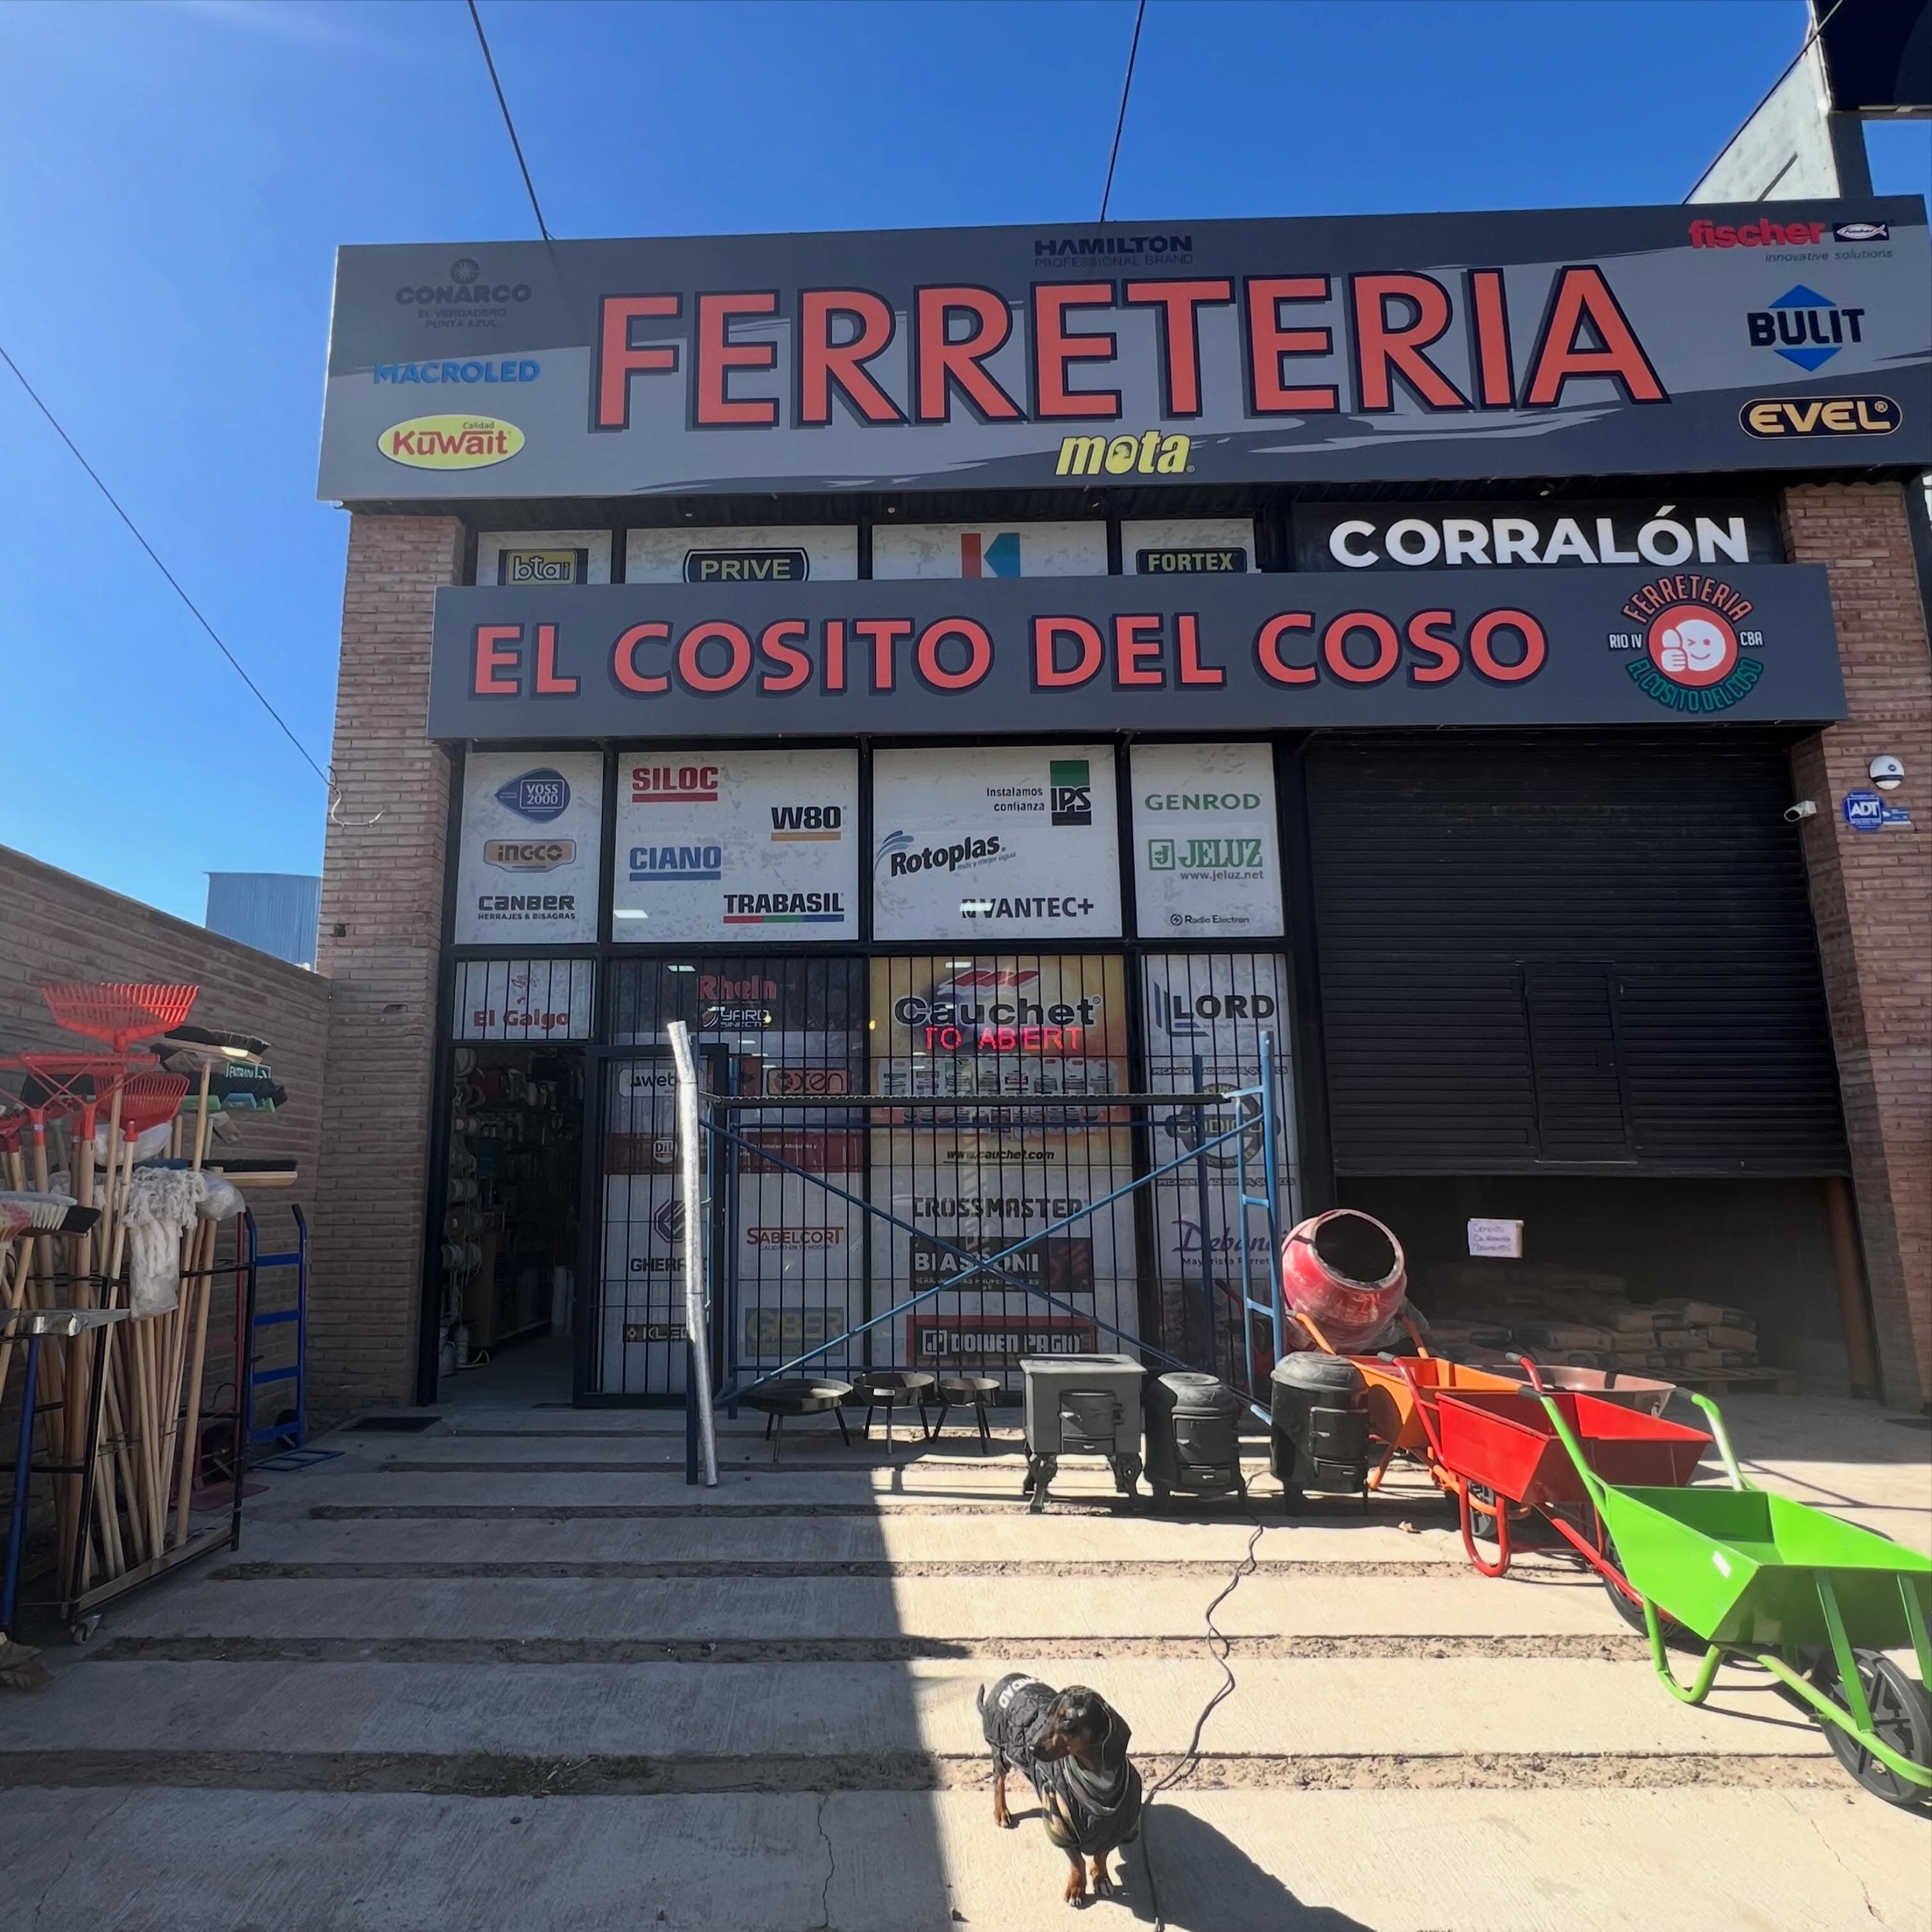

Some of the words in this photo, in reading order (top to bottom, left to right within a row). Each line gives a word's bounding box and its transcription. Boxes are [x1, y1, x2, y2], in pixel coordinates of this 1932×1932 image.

[1688, 218, 1826, 249] fischer
[1034, 235, 1193, 257] HAMILTON
[1765, 252, 1829, 263] innovative
[1834, 249, 1894, 261] solutions
[1034, 256, 1140, 269] PROFESSIONAL
[1145, 254, 1193, 266] BRAND
[395, 283, 532, 305] CONARCO
[418, 309, 431, 318] EL
[434, 307, 507, 318] VERDADERO
[425, 319, 464, 328] PUNTA
[467, 318, 498, 328] AZUL
[1747, 308, 1866, 347] BULIT
[594, 264, 1673, 431] FERRETERIA
[374, 360, 541, 385] MACROLED
[463, 420, 494, 430] Calidad
[1749, 400, 1891, 434] EVEL
[1054, 429, 1192, 476] mota
[1329, 505, 1750, 567] CORRALÓN
[700, 558, 792, 581] PRIVE
[1148, 551, 1235, 572] FORTEX
[1622, 575, 1753, 624] FERRETERIA
[1609, 634, 1629, 649] RIO
[1631, 634, 1642, 648] IV
[1740, 631, 1763, 646] CBA
[473, 622, 581, 695] EL
[611, 615, 994, 694] COSITO
[1031, 612, 1226, 690] DEL
[1256, 607, 1549, 686] COSO
[526, 783, 559, 794] VOSS
[632, 767, 719, 790] SILOC
[526, 795, 559, 805] 2000
[986, 786, 1043, 797] Instalamos
[1050, 786, 1092, 812] IPS
[1144, 793, 1261, 811] GENROD
[770, 806, 841, 829] W80
[993, 801, 1045, 812] confianza
[1850, 801, 1880, 816] ADT
[629, 845, 721, 870] CIANO
[890, 835, 1000, 877] Rotoplas
[1178, 839, 1263, 868] JELUZ
[1180, 870, 1264, 882] www.jeluz.net
[723, 893, 845, 914] TRABASIL
[1184, 915, 1211, 924] Radio
[1212, 914, 1250, 924] Electron
[894, 997, 1094, 1025] Cauchet
[1173, 995, 1275, 1019] LORD
[473, 1009, 495, 1027] El
[503, 1008, 569, 1030] Galgo
[746, 1226, 844, 1245] SABELCORT
